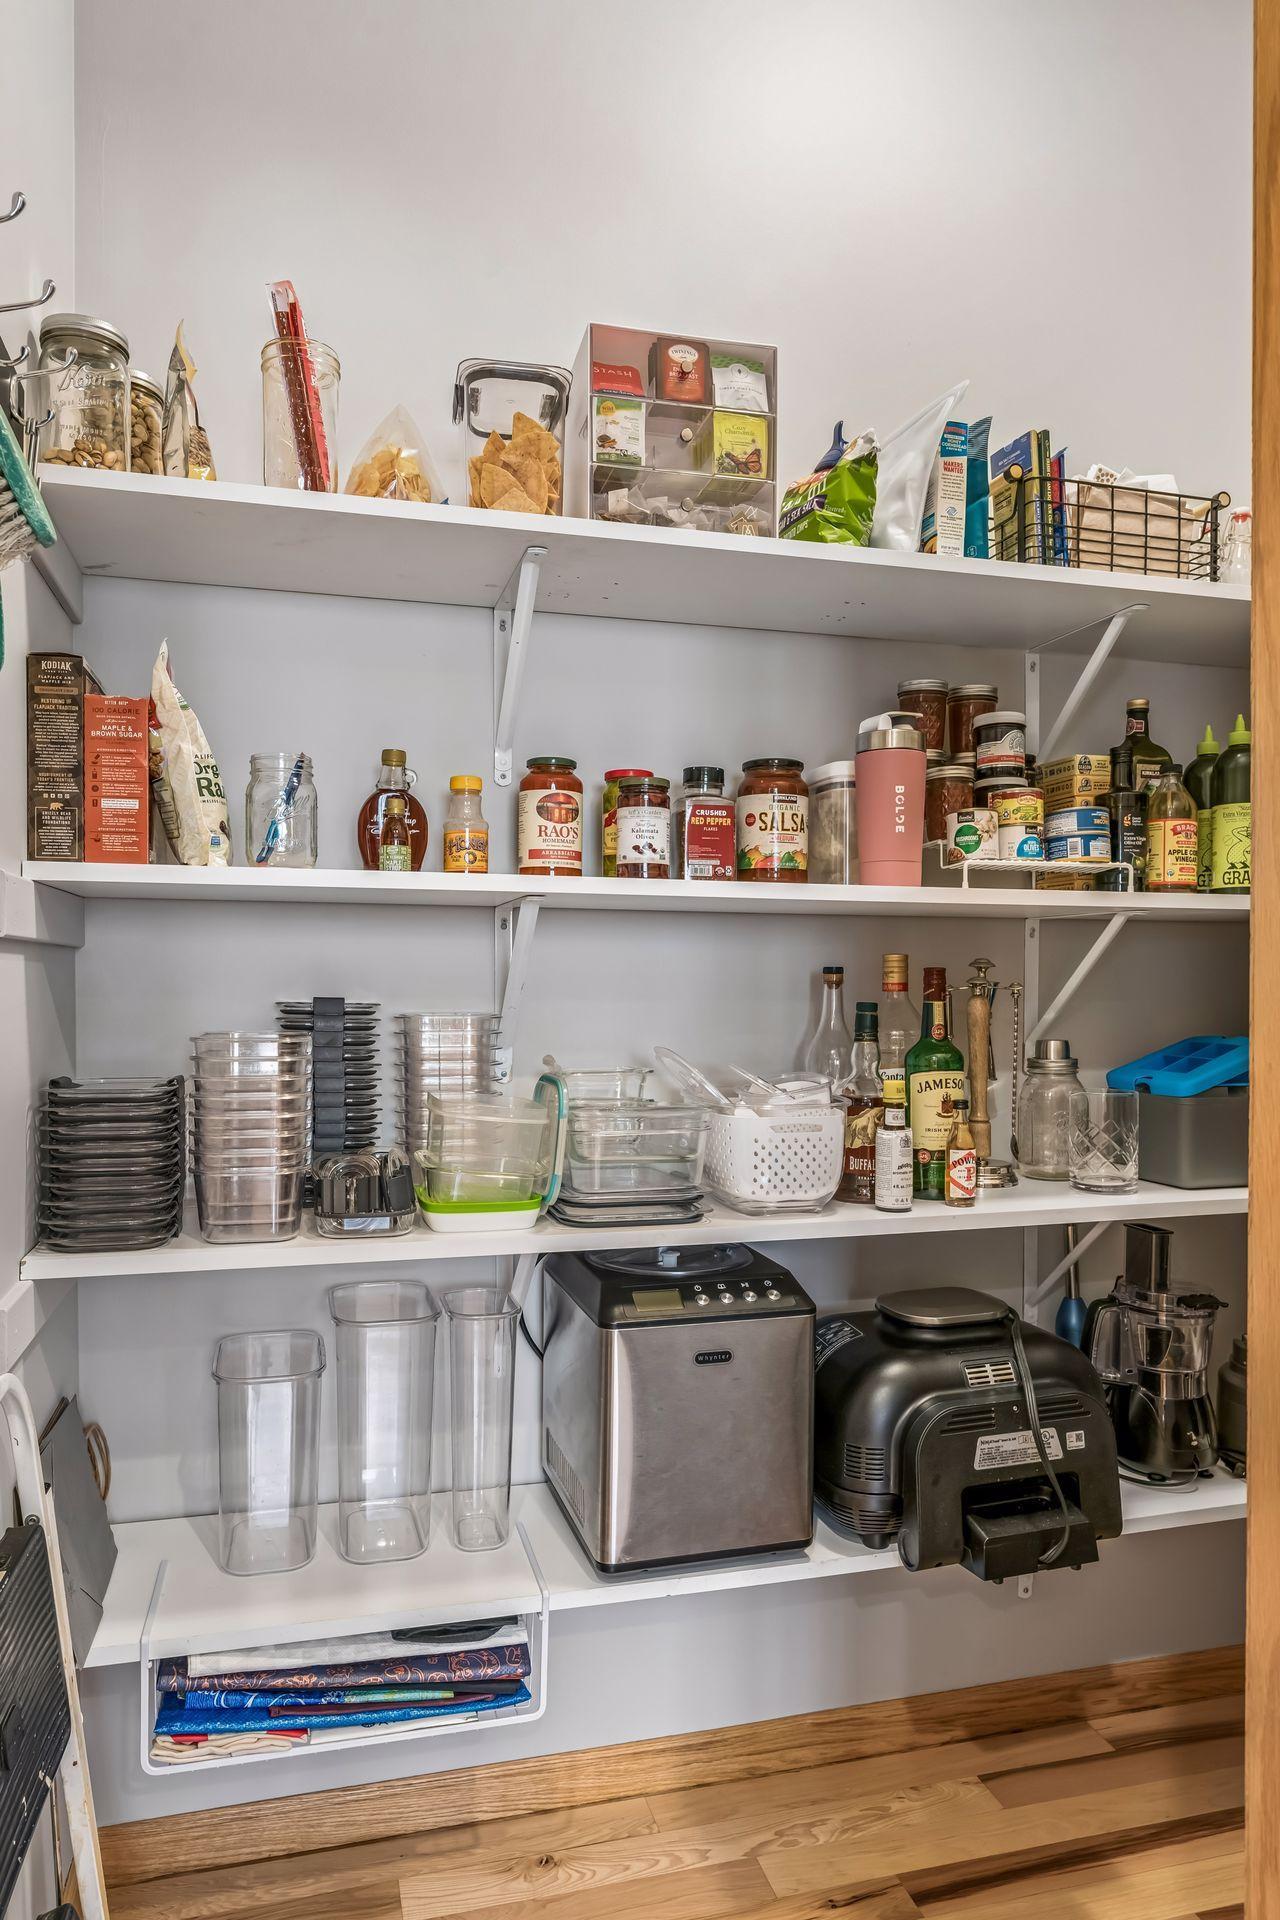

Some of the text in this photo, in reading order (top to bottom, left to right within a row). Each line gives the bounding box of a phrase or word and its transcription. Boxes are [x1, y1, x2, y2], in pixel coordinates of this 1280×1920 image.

[593, 367, 632, 378] STASH
[943, 460, 964, 469] MAKERS
[943, 467, 964, 475] WANTED
[41, 660, 72, 671] KODIAK
[768, 803, 802, 812] ORGANIC
[895, 785, 905, 833] BOLDE
[695, 809, 728, 817] CRUSHED
[690, 816, 732, 826] RED PEPPER
[758, 811, 806, 834] SALSA
[537, 825, 579, 839] RAO'S
[1023, 843, 1040, 852] OLIVES
